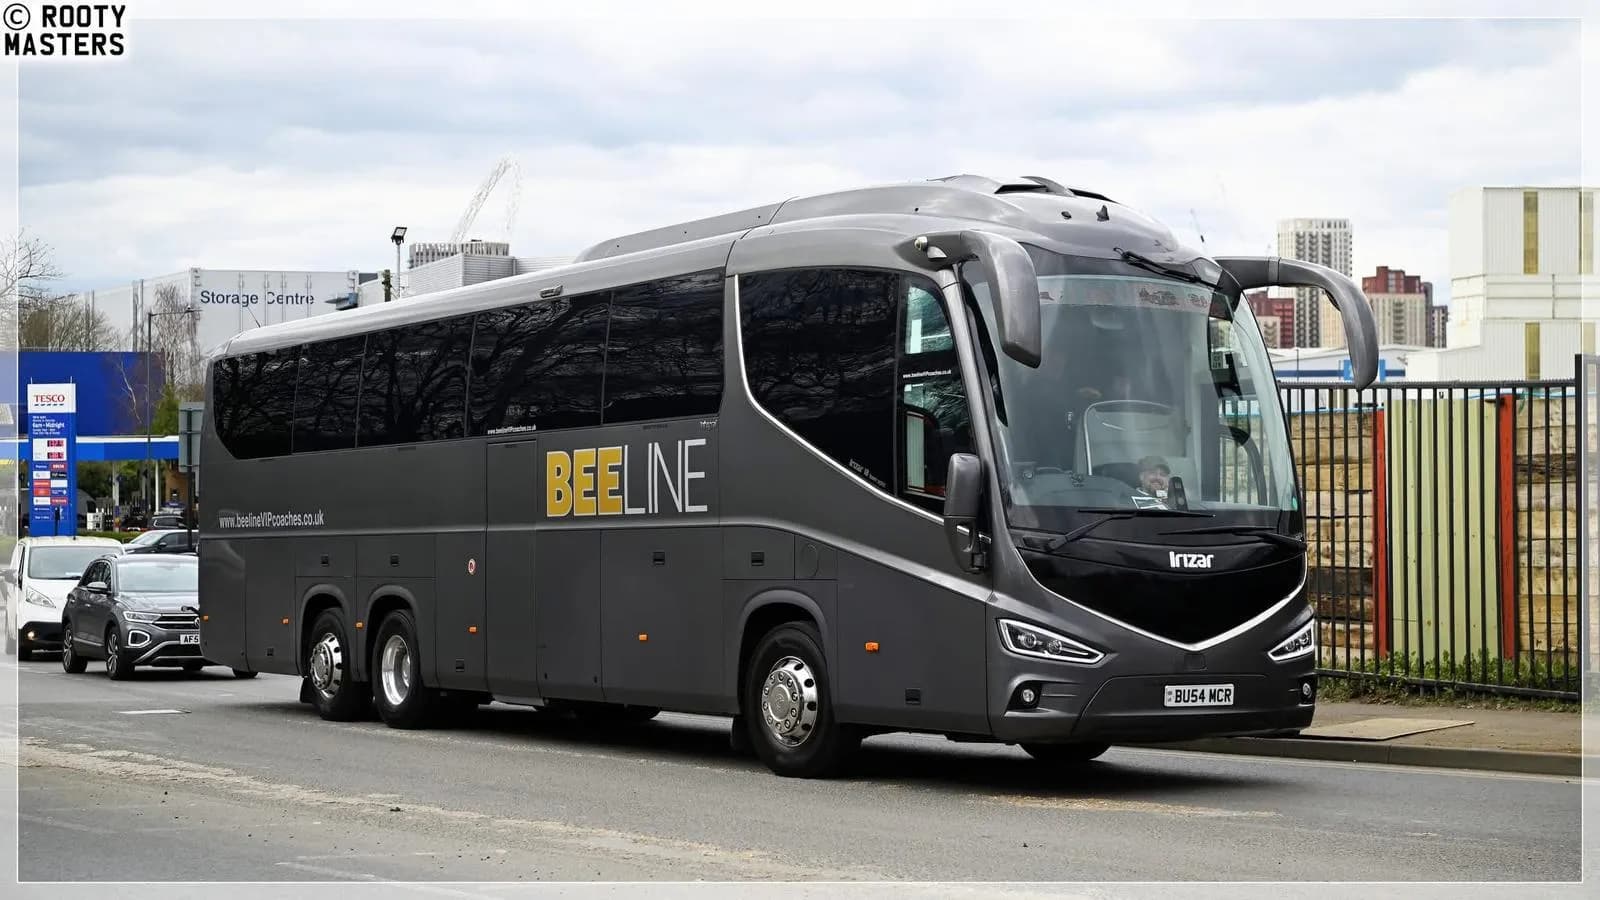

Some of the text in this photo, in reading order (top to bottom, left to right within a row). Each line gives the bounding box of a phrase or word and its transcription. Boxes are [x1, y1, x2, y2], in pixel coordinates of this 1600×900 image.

[200, 290, 314, 308] Storage Centre
[34, 394, 66, 403] TESCO
[546, 438, 708, 518] BEELINE
[219, 509, 325, 528] www.beelineVIPcoaches.co.uk
[1169, 551, 1214, 568] Irizar
[1175, 688, 1232, 703] BU54 MCR
